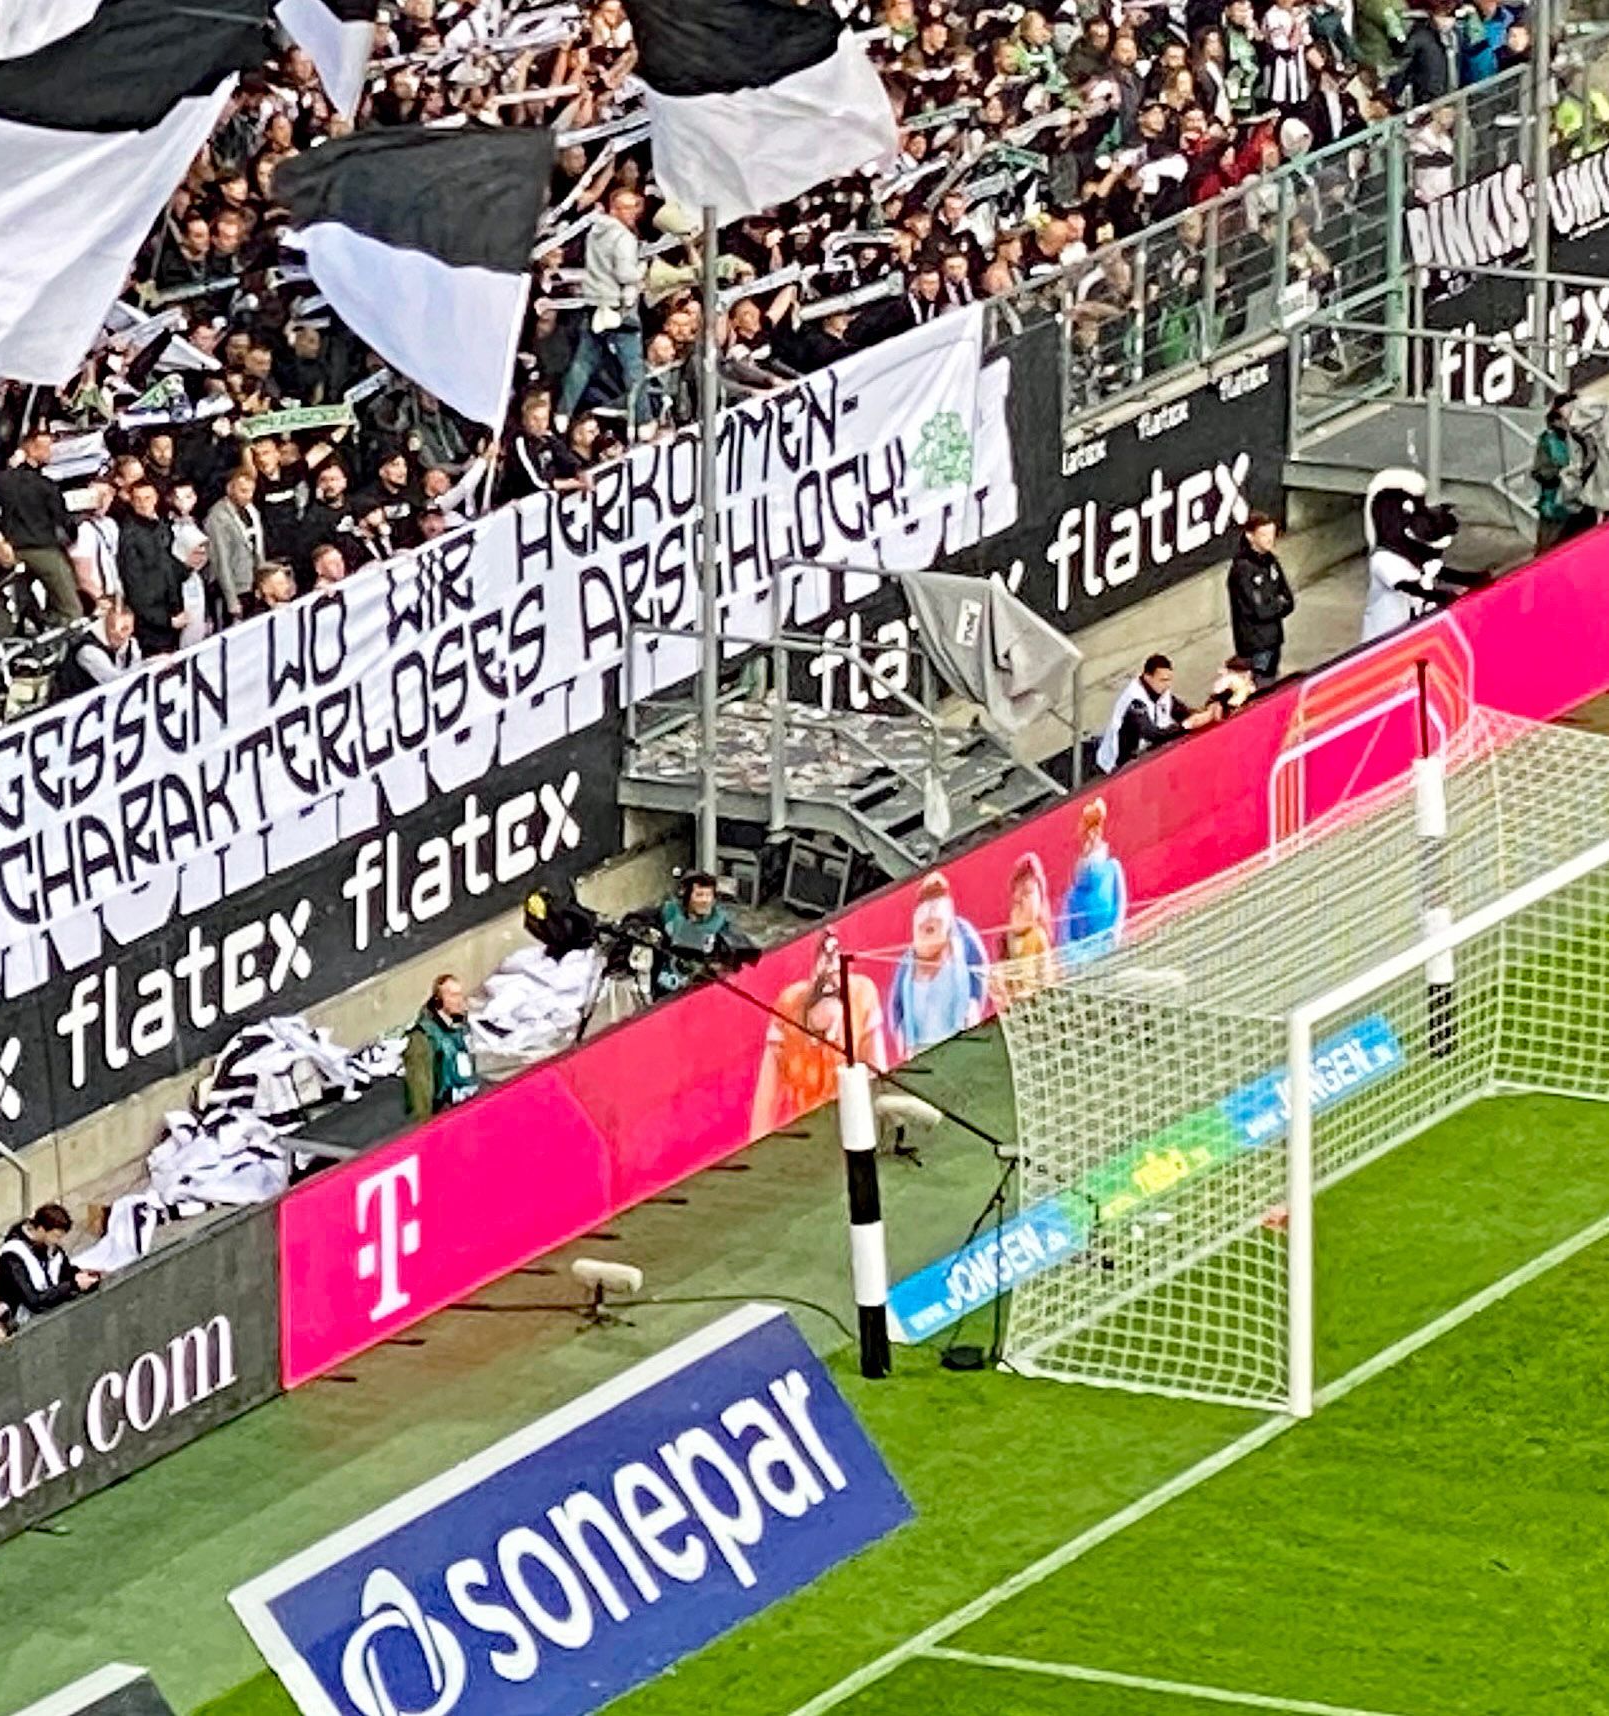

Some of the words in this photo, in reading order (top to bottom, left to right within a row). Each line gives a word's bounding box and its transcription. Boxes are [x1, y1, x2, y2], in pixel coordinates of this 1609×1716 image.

[267, 593, 347, 698] WO
[388, 529, 477, 646] WIR
[1047, 453, 1251, 612] flatex
[343, 770, 581, 951] flatex
[58, 899, 310, 1089] flatex
[446, 1369, 847, 1682] sonepar
